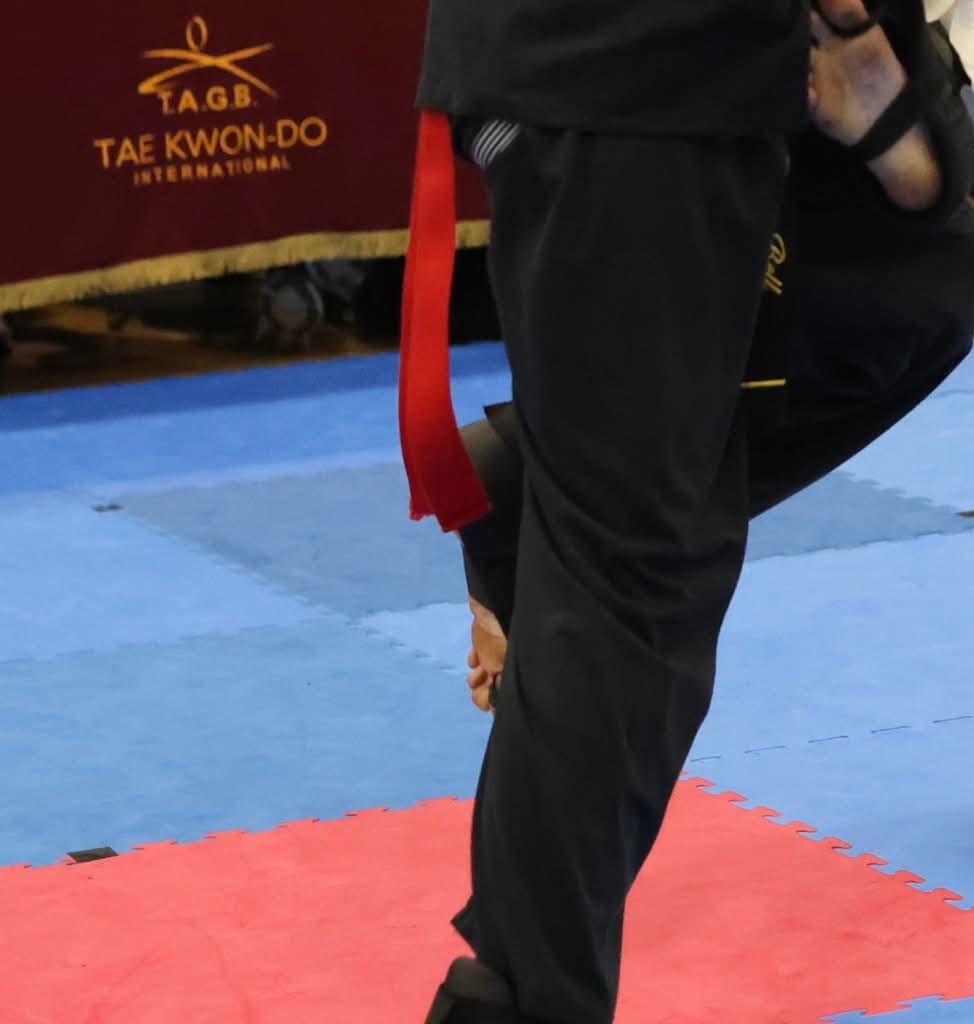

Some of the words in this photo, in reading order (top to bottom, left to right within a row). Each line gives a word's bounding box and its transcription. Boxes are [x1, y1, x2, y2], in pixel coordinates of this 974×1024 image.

[93, 134, 156, 169] TAE
[163, 116, 328, 160] KWON-DO
[131, 154, 292, 187] INTERNATIONAL
